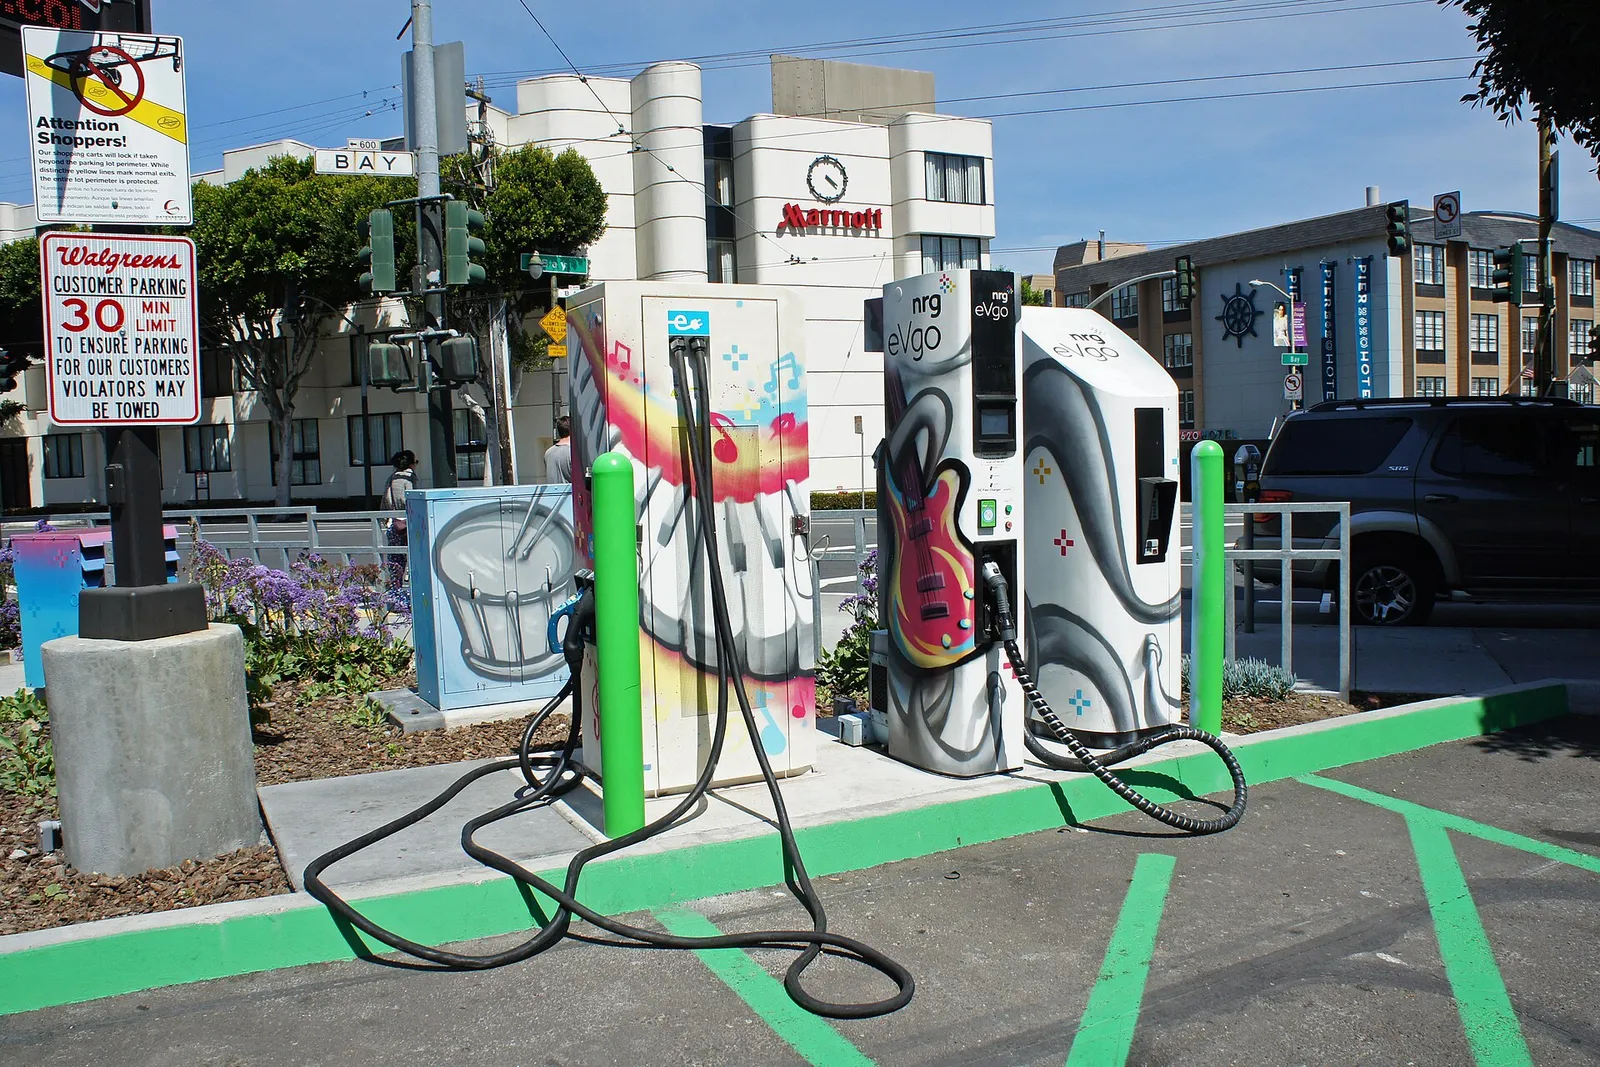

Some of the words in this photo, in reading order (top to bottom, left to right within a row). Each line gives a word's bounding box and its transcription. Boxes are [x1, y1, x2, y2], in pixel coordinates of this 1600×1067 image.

[36, 116, 119, 132] Attention
[37, 132, 127, 148] Shoppers!
[359, 140, 376, 149] 600
[335, 154, 396, 170] BAY
[778, 202, 882, 229] Marriott
[56, 246, 182, 274] Walgreens
[542, 259, 568, 271] Bay
[54, 275, 123, 294] CUSTOMER
[131, 278, 186, 295] PARKING
[1358, 264, 1367, 303] PIER
[992, 290, 1008, 303] nrg
[142, 301, 170, 314] MIN
[912, 293, 942, 318] nrg
[975, 302, 1008, 320] eVgo
[61, 298, 124, 332] 30
[136, 319, 176, 332] LIMIT
[57, 337, 72, 353] TO
[81, 337, 128, 354] ENSURE
[135, 338, 188, 354] PARKING
[888, 320, 942, 361] eVgo
[1070, 332, 1106, 344] nrg
[1054, 342, 1120, 362] eVgo
[1290, 355, 1300, 364] Bay
[57, 359, 80, 375] FOR
[88, 359, 112, 375] OUR
[120, 359, 190, 376] CUSTOMERS
[1360, 351, 1371, 399] HOTE
[1325, 354, 1335, 399] HOTE
[62, 381, 145, 397] VIOLATORS
[156, 381, 185, 397] MAY
[93, 403, 109, 418] BE
[116, 402, 159, 418] TOWED
[1181, 431, 1198, 440] 620
